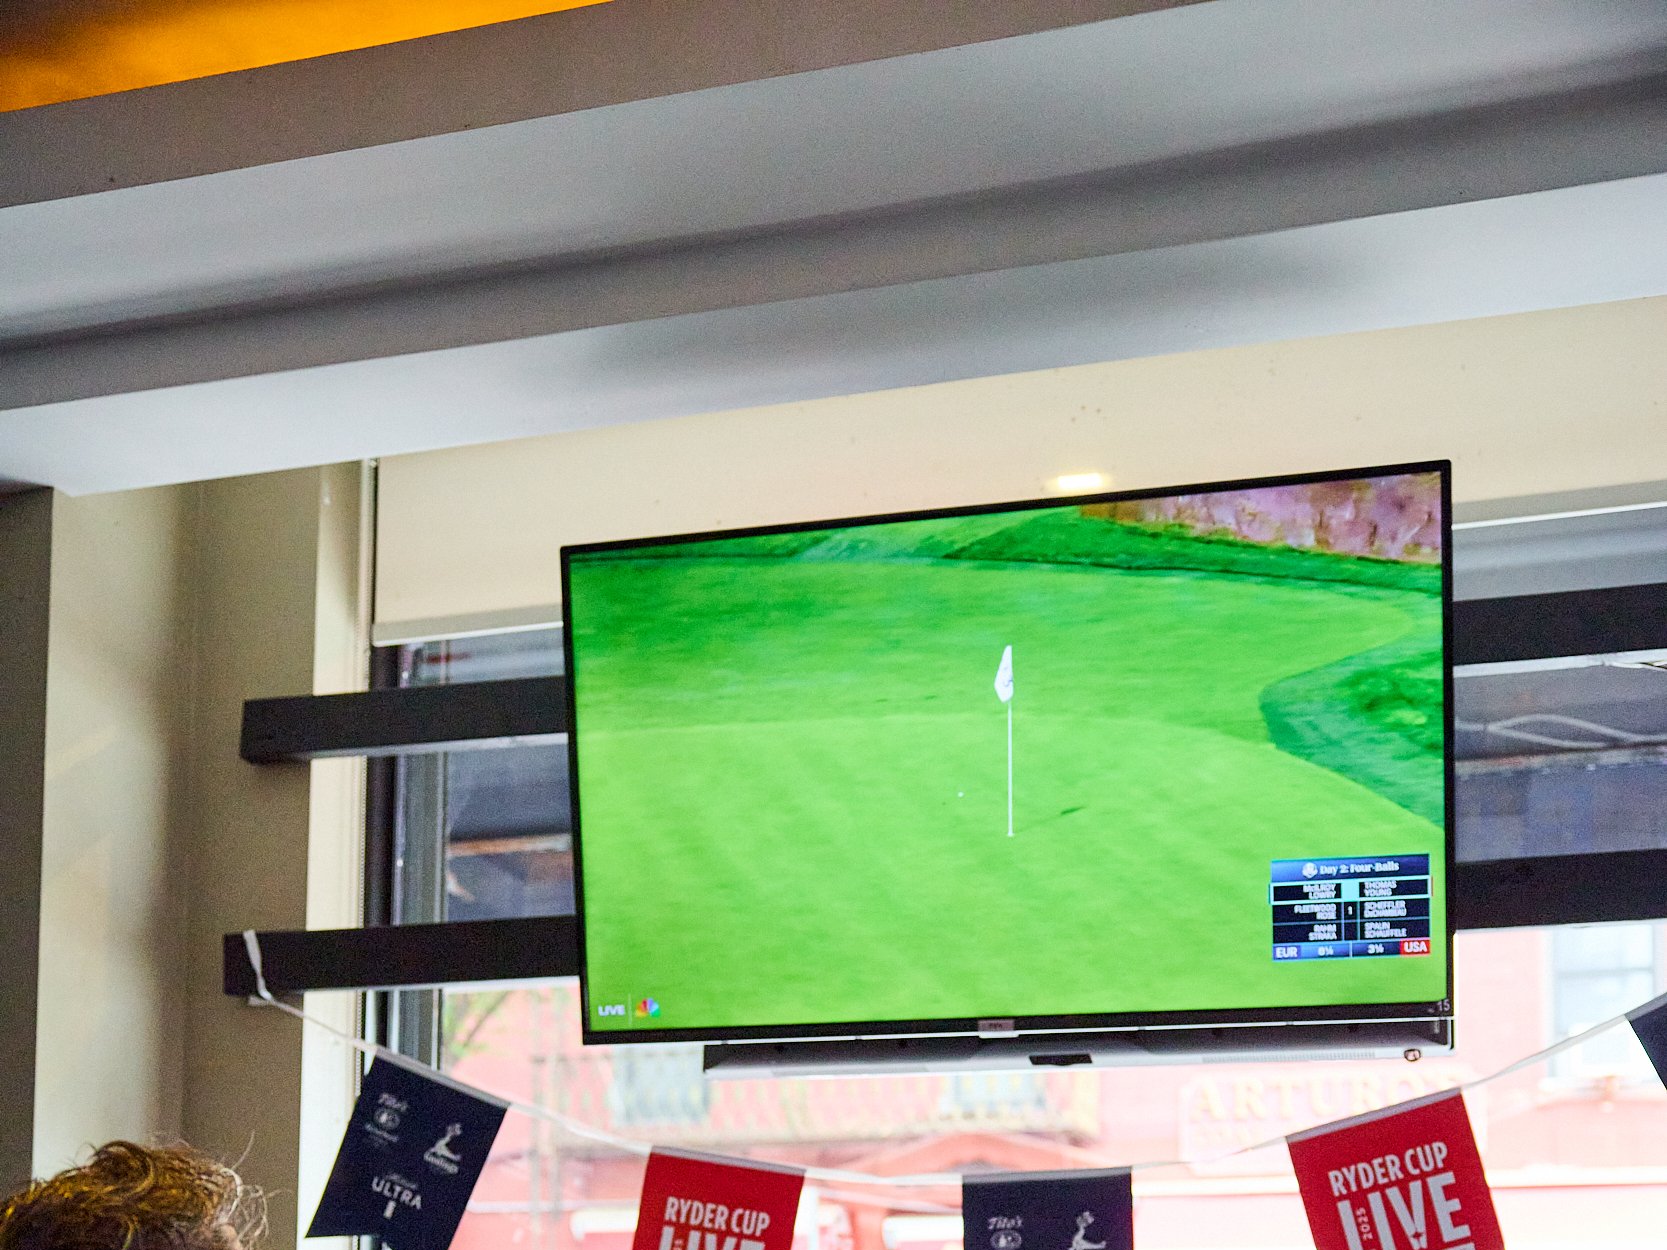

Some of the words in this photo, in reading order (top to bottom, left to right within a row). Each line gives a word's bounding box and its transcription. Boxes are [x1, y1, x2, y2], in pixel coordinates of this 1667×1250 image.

[1320, 865, 1338, 876] Day
[1350, 861, 1399, 873] Four-Balls
[1275, 946, 1298, 958] EUR
[1403, 940, 1428, 953] USA
[598, 1004, 625, 1016] LIVE
[1437, 999, 1451, 1012] 15
[1328, 1153, 1404, 1197] RYDER
[1404, 1141, 1448, 1175] CUP
[371, 1176, 422, 1210] ULTRA
[664, 1196, 729, 1231] RYDER
[730, 1207, 771, 1237] CUP
[1355, 1206, 1374, 1241] 2025
